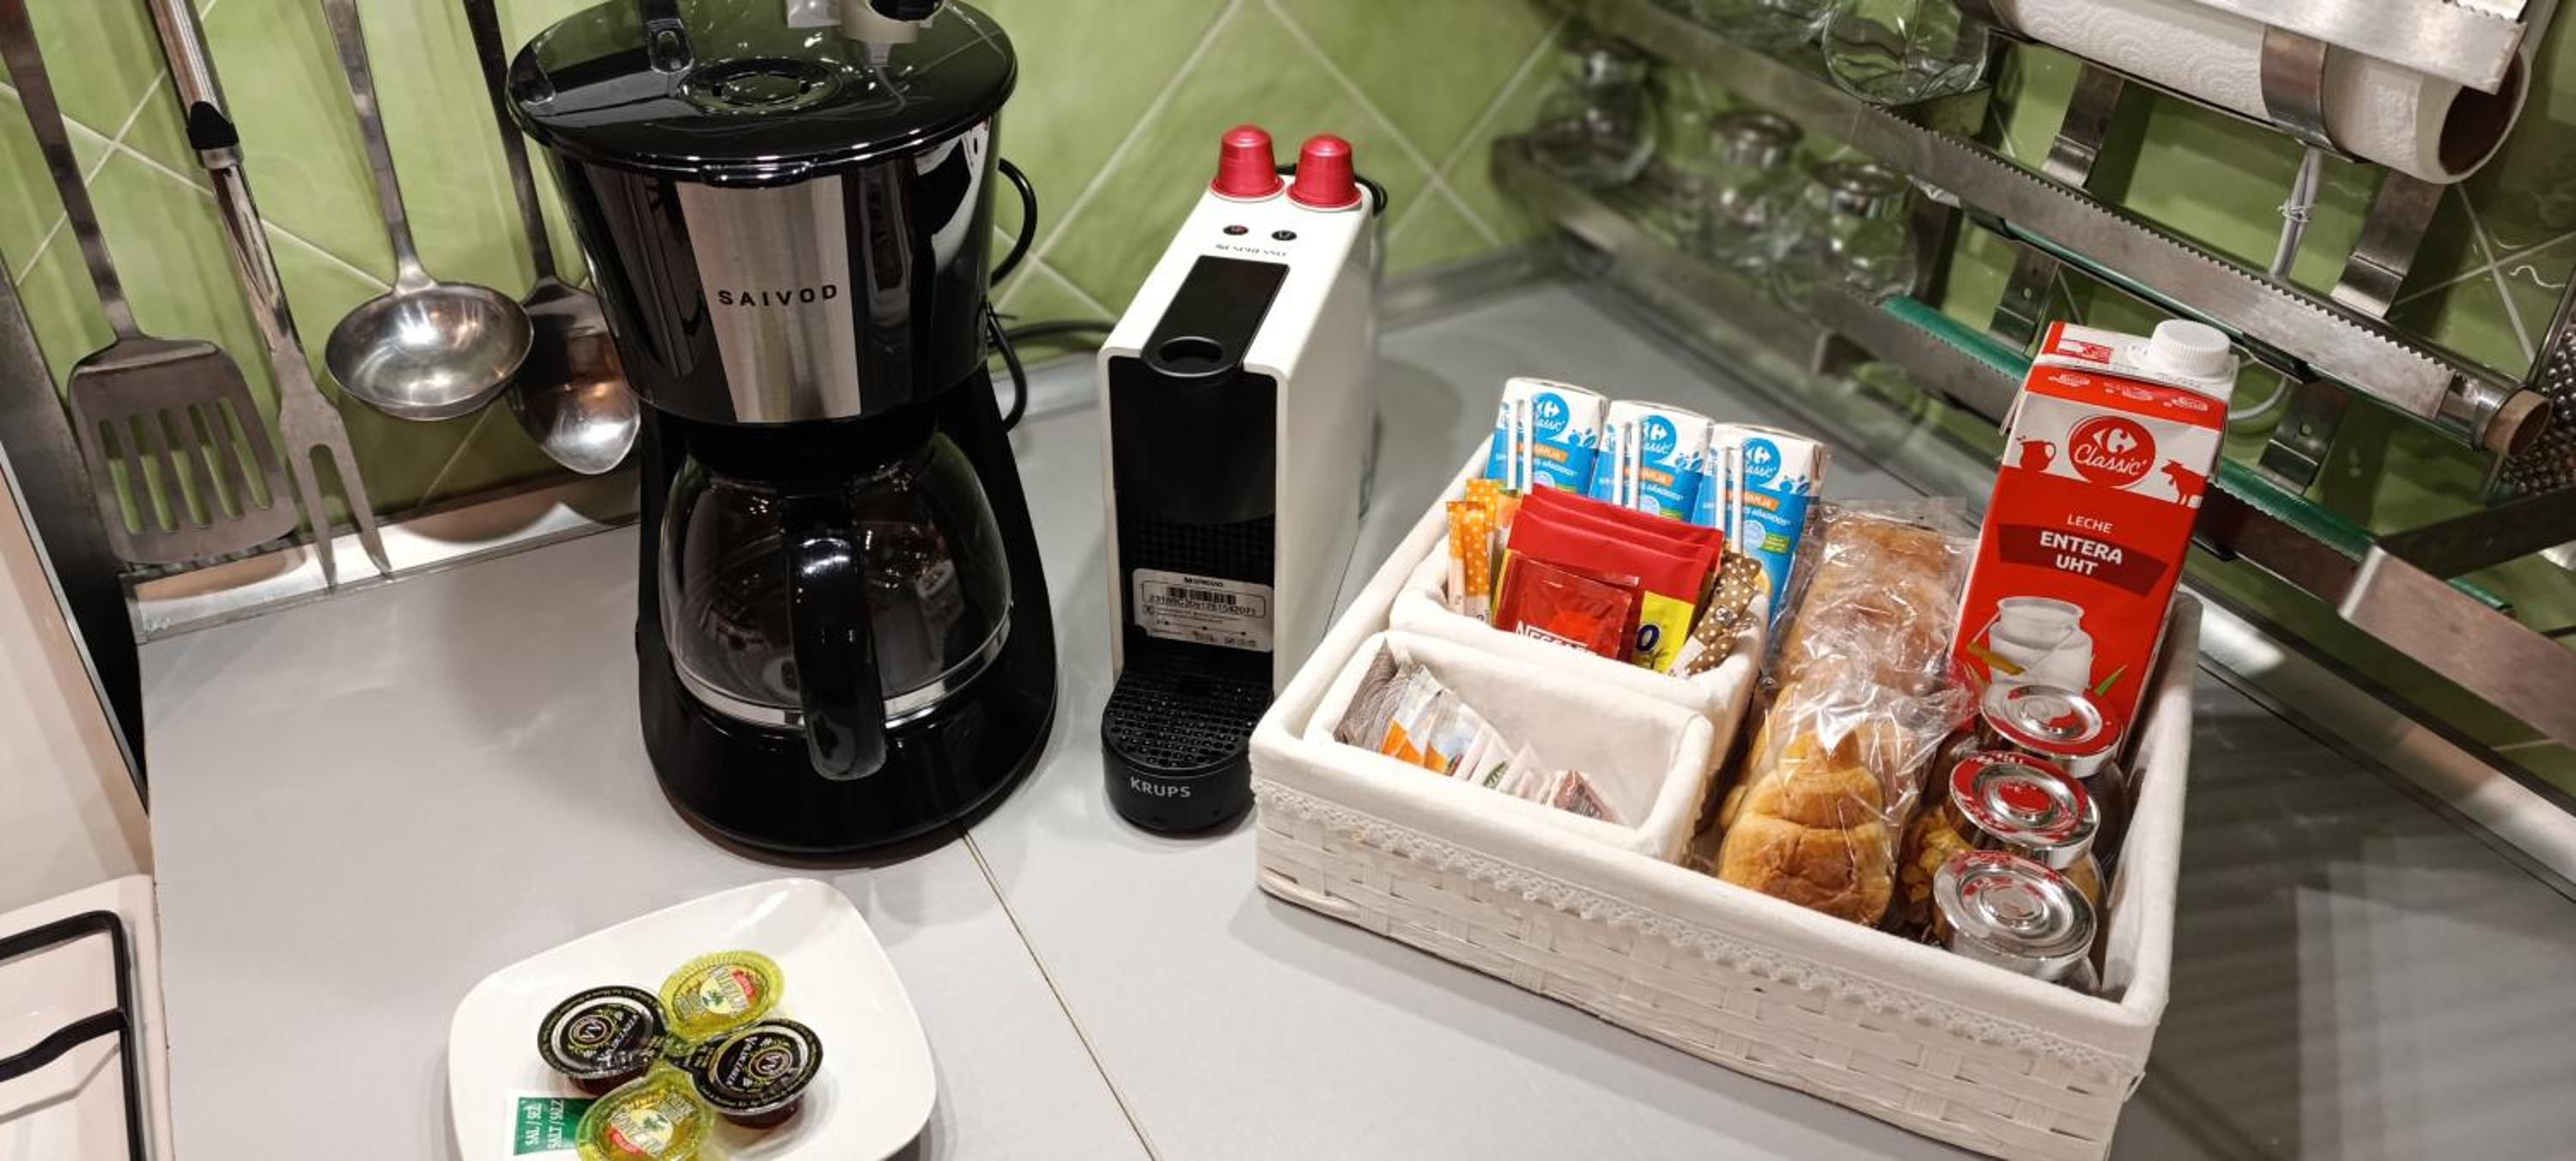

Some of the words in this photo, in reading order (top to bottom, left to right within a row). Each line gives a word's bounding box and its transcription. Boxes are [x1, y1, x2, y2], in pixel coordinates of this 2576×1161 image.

[718, 284, 837, 307] SAIVOD
[2067, 514, 2113, 534] LECHE
[2040, 531, 2123, 564] ENTERA
[2056, 554, 2099, 575] UHT
[1130, 776, 1191, 798] KRUPS
